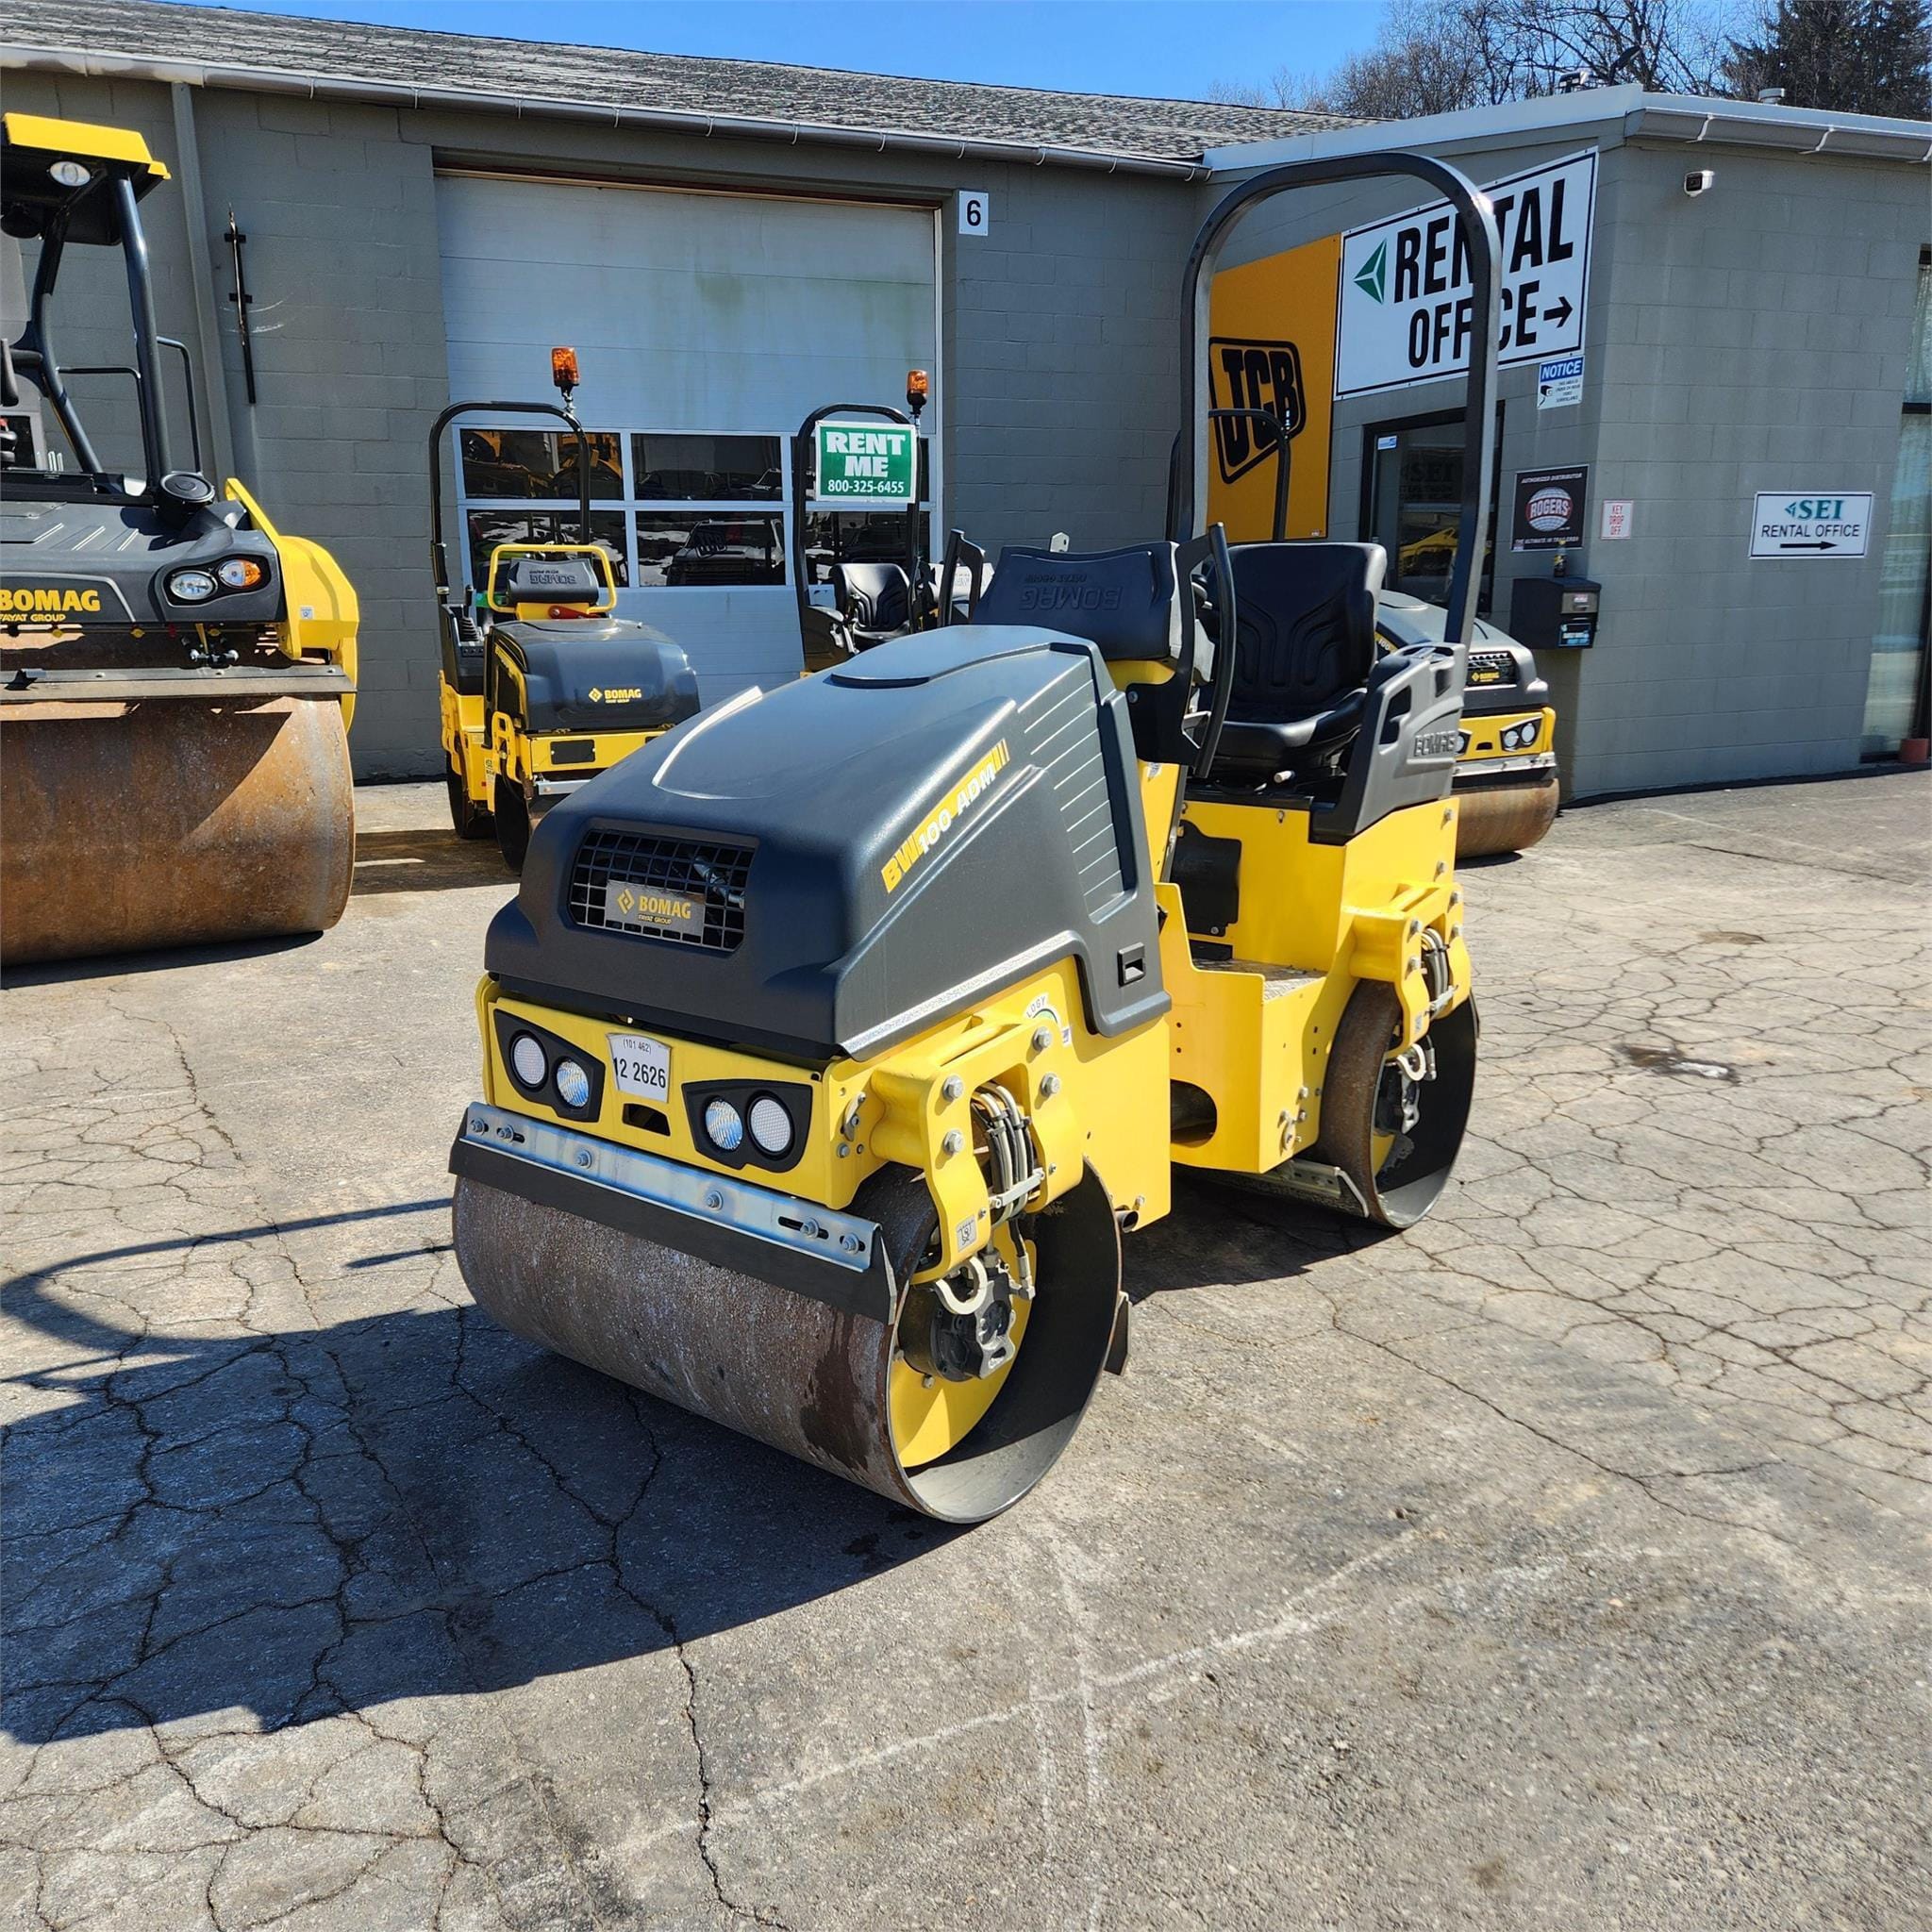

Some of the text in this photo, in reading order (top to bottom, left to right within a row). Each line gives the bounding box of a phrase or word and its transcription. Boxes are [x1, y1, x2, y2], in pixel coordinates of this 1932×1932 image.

[967, 199, 981, 226] 6
[1541, 359, 1582, 379] NOTICE
[1222, 347, 1299, 468] JCB
[825, 431, 906, 456] RENT
[844, 455, 889, 477] ME
[827, 479, 905, 493] 800-325-6455
[1530, 498, 1570, 517] ROGERS
[1798, 499, 1844, 520] SEI
[1761, 524, 1860, 538] RENTAL OFFICE
[0, 589, 101, 611] BOMAG
[1020, 586, 1124, 611] BOMAG
[30, 613, 66, 623] GROUP
[604, 689, 642, 700] BOMAG
[639, 895, 691, 920] BOMAG
[633, 1061, 666, 1089] 2626
